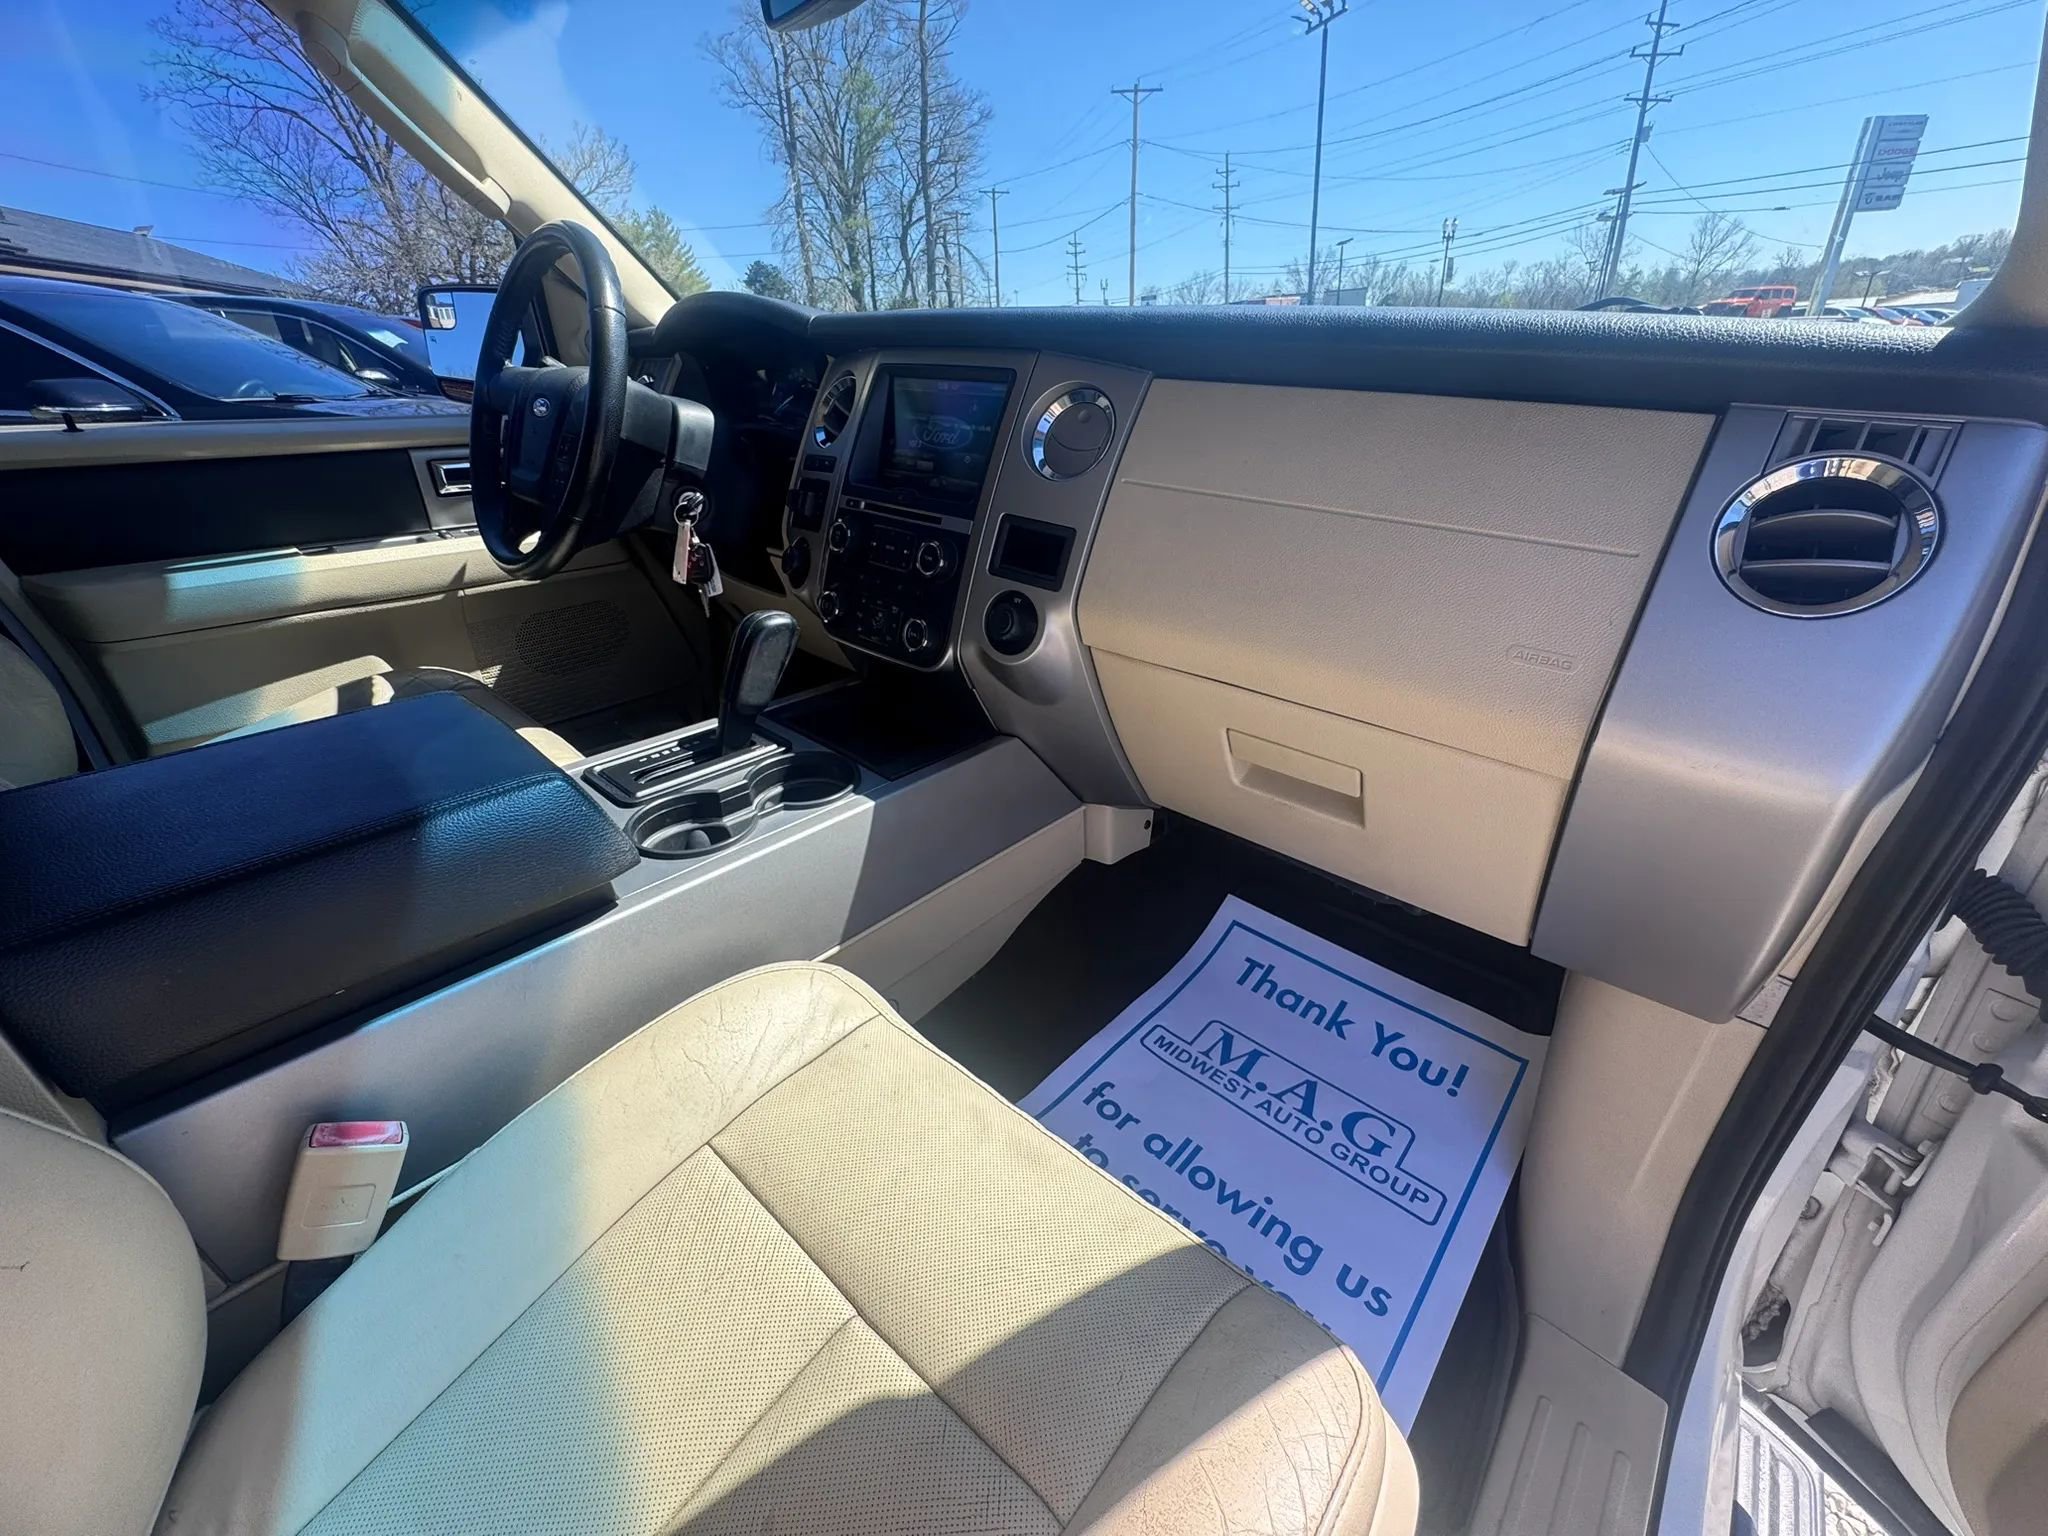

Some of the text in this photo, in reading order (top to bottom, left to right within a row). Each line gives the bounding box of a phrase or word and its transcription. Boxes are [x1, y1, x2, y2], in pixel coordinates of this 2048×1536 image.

[1512, 650, 1573, 671] AIRBAG
[1236, 957, 1470, 1098] Thank You!
[1153, 1034, 1431, 1206] MIDWEST AUTO GROUP
[1081, 1080, 1142, 1132] for
[1143, 1132, 1325, 1277] allowing
[1335, 1263, 1394, 1318] us
